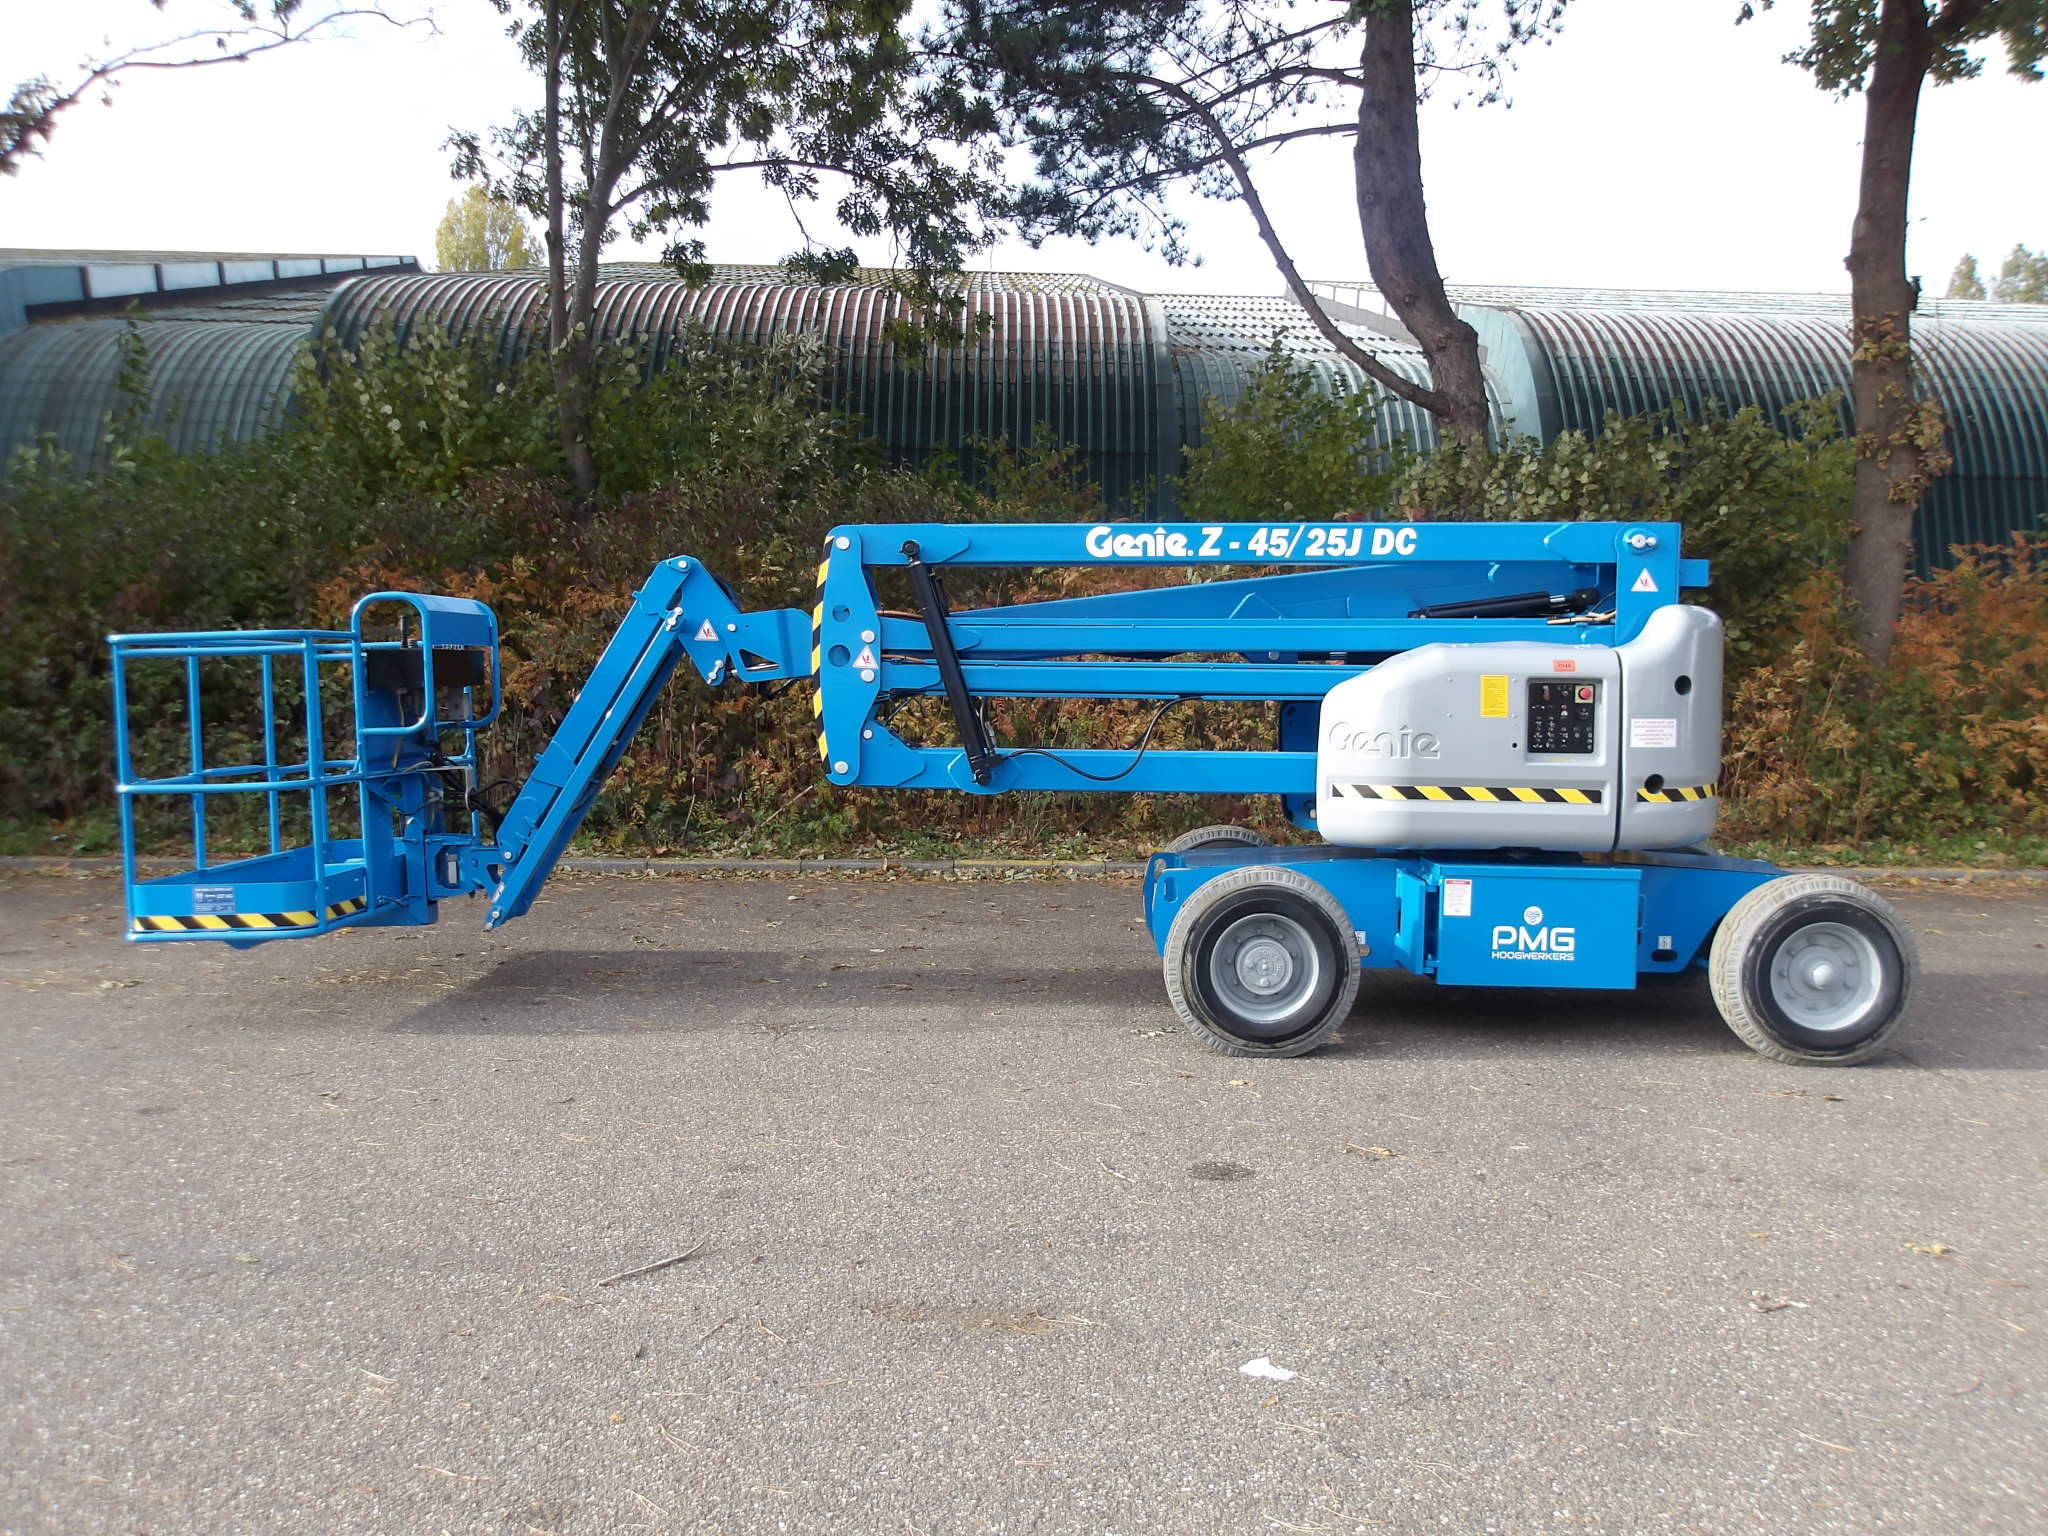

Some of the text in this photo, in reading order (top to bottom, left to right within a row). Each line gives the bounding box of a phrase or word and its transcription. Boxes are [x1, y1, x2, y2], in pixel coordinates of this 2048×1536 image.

[1086, 526, 1187, 558] Genie
[1199, 527, 1223, 557] Z
[1371, 528, 1417, 556] DC
[1328, 721, 1440, 760] Genie
[1492, 925, 1576, 951] PMG
[1491, 951, 1575, 961] HOOGWERKERS
